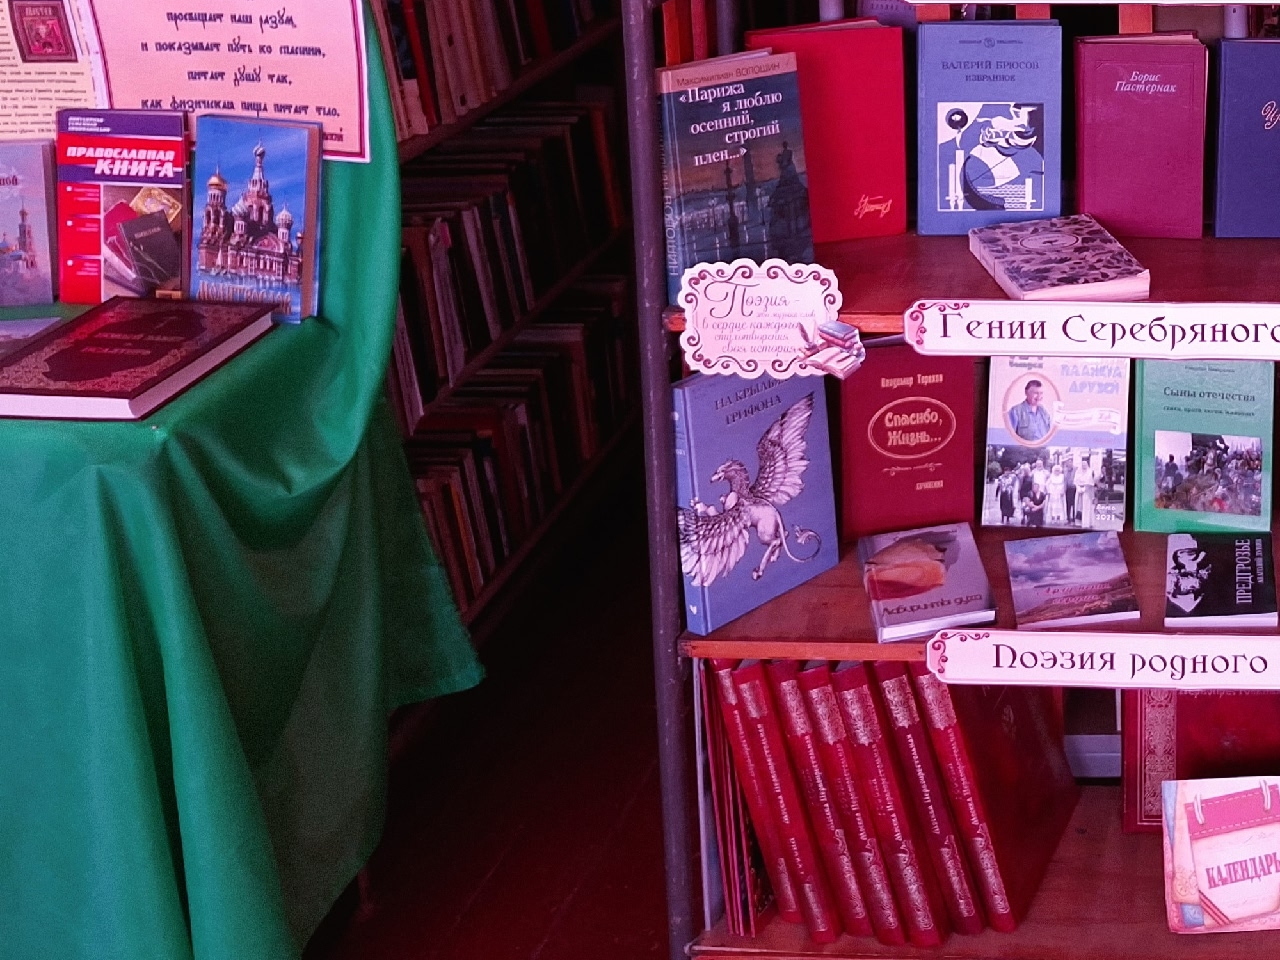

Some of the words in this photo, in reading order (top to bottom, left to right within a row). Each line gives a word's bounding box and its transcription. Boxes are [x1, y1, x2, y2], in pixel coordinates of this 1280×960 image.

[735, 62, 781, 78] ВОЛОШИН
[942, 59, 992, 71] ВАЛЕРИЙ
[995, 59, 1040, 71] БРЮСОВ
[965, 73, 1016, 83] ИЗБРАННОЕ
[1115, 81, 1177, 93] Пастернак
[1130, 71, 1161, 83] Борис
[679, 83, 745, 104] «Парижа
[722, 103, 731, 113] я
[734, 91, 782, 112] люблю
[690, 112, 754, 134] осенний,
[725, 120, 780, 144] строгий
[67, 146, 175, 161] ПРАВОСЛАВНАЯ
[704, 281, 790, 318] Поэзия
[939, 312, 1048, 342] Гении
[1163, 386, 1197, 398] Сыны
[1198, 391, 1256, 402] отечества
[885, 408, 943, 428] Спасибо,
[1236, 538, 1254, 605] ПРЕДГРОЗЬЕ
[992, 642, 1117, 673] Поэзия
[1130, 651, 1268, 685] родного
